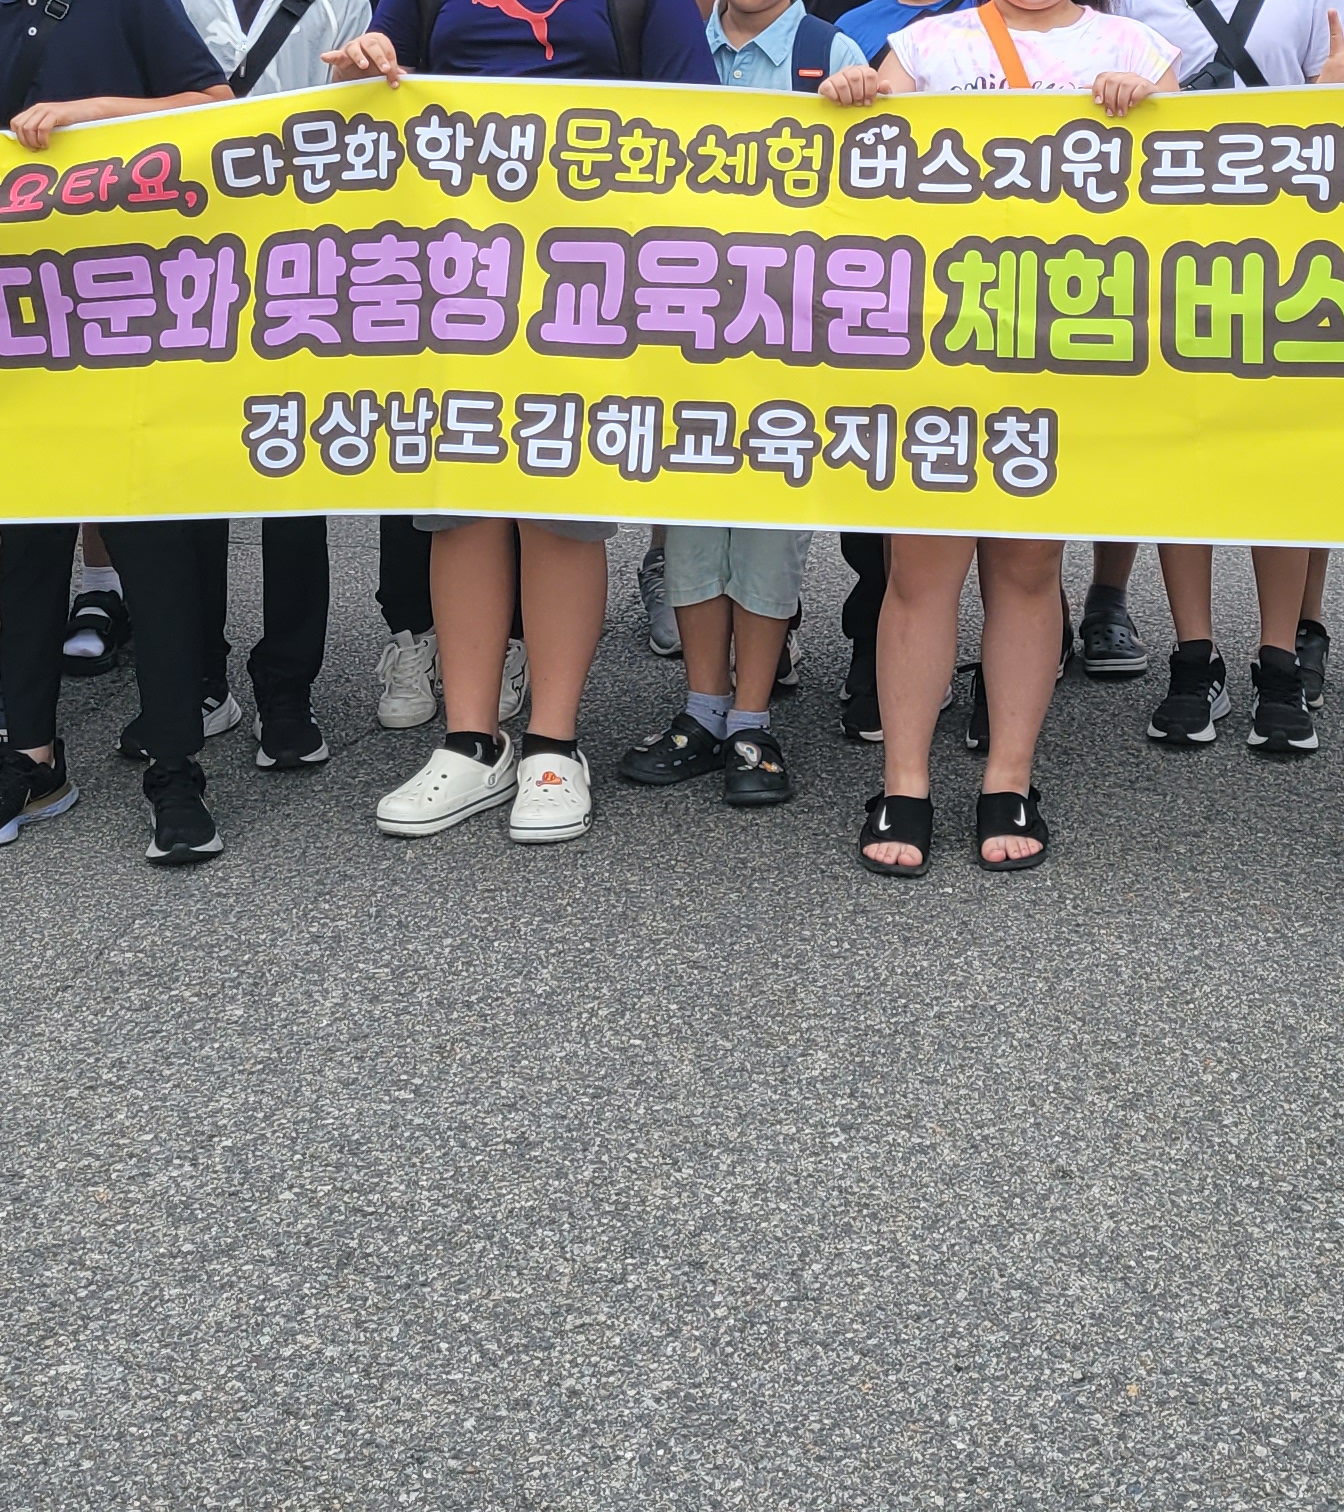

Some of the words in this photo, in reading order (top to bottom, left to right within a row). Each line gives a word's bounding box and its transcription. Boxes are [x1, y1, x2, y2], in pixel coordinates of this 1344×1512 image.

[222, 120, 397, 194] 다문화
[416, 114, 537, 192] 학생
[560, 118, 677, 191] 문화
[698, 126, 824, 199] 체험
[263, 231, 512, 346] 맞춤형
[540, 239, 913, 357] 교육지원
[946, 248, 1136, 362] 체험
